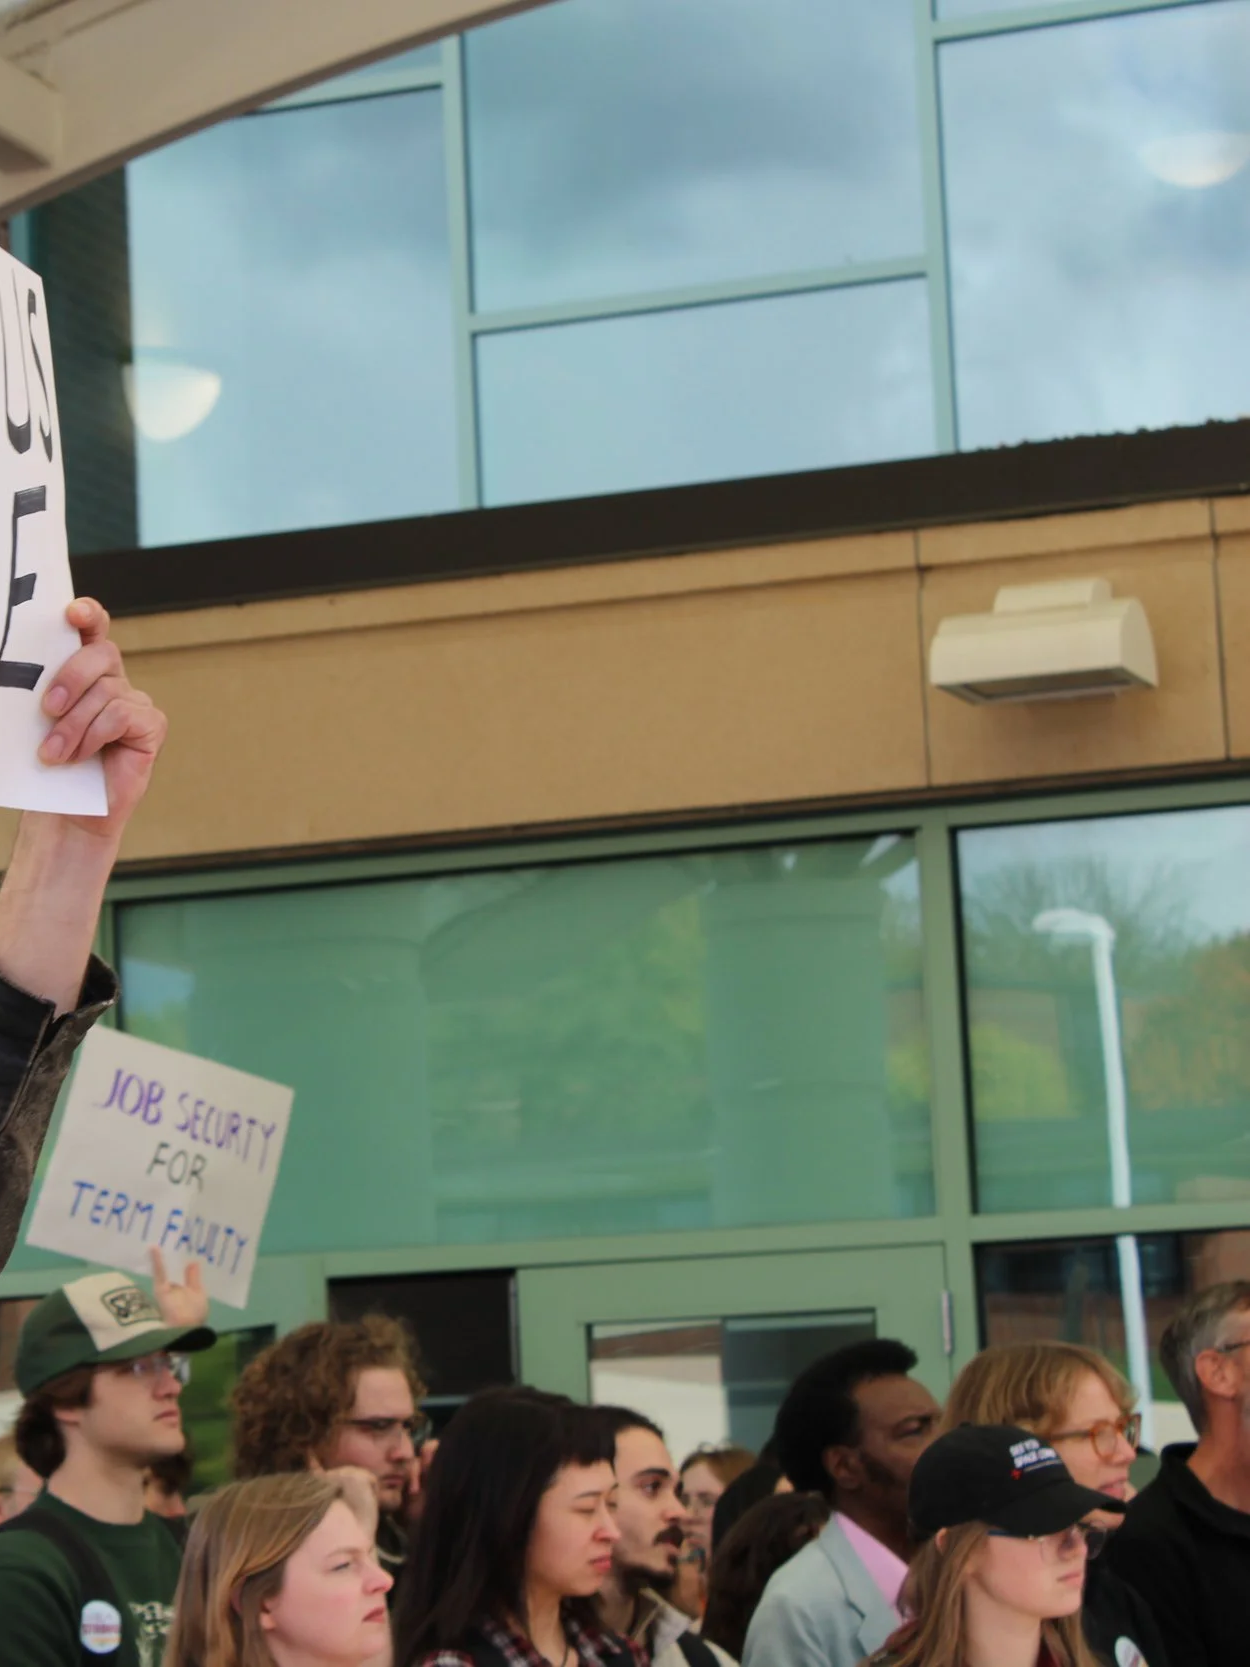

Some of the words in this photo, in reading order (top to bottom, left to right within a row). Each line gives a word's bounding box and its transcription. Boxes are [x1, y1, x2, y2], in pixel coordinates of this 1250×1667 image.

[93, 1067, 166, 1126] JOB
[145, 1141, 207, 1193] FOR
[69, 1179, 155, 1243] TERM
